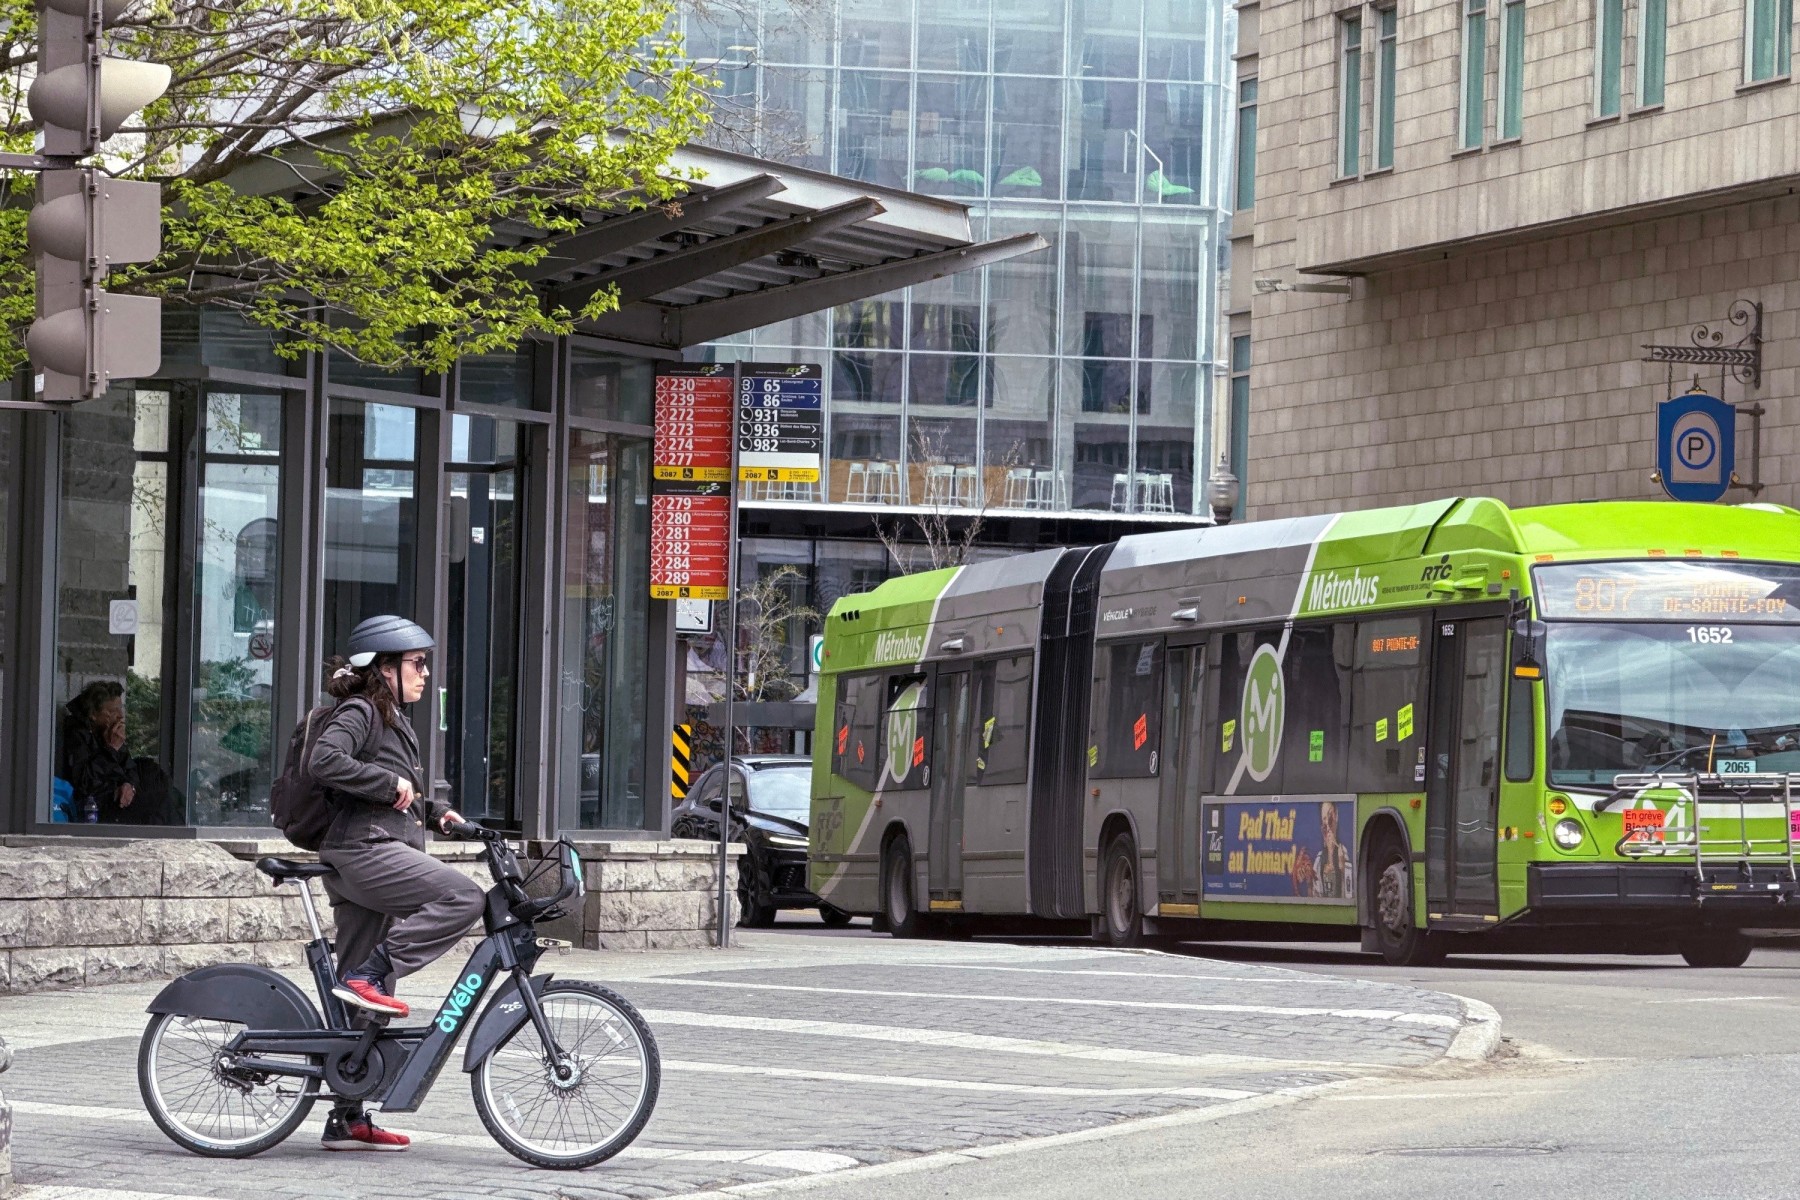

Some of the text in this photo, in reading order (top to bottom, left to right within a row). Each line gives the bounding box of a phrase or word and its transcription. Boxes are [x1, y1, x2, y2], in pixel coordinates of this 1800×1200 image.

[670, 378, 695, 391] 230
[763, 379, 780, 392] 65
[669, 393, 695, 406] 239
[763, 394, 780, 407] 86
[669, 408, 694, 421] 272
[754, 409, 778, 422] 931
[669, 423, 693, 436] 273
[754, 424, 779, 437] 936
[668, 438, 693, 451] 274
[753, 439, 778, 452] 982
[1688, 436, 1704, 460] P
[668, 453, 693, 466] 277
[666, 497, 692, 510] 279
[666, 512, 691, 525] 280
[666, 527, 689, 540] 281
[665, 542, 691, 555] 282
[665, 557, 690, 570] 284
[664, 571, 690, 585] 289
[1421, 564, 1453, 581] RTC
[1307, 567, 1379, 611] Métrobus
[1575, 578, 1637, 612] 807
[1663, 598, 1786, 613] DE-SAINTE-FOY
[1441, 624, 1455, 636] 1652
[1687, 627, 1733, 644] 1652
[874, 628, 922, 662] Métrobus
[1724, 761, 1750, 773] 2065
[1625, 811, 1662, 822] En grève
[1238, 808, 1297, 842] Pad Thaï
[1227, 843, 1297, 875] au homard
[435, 973, 482, 1033] àVélo
